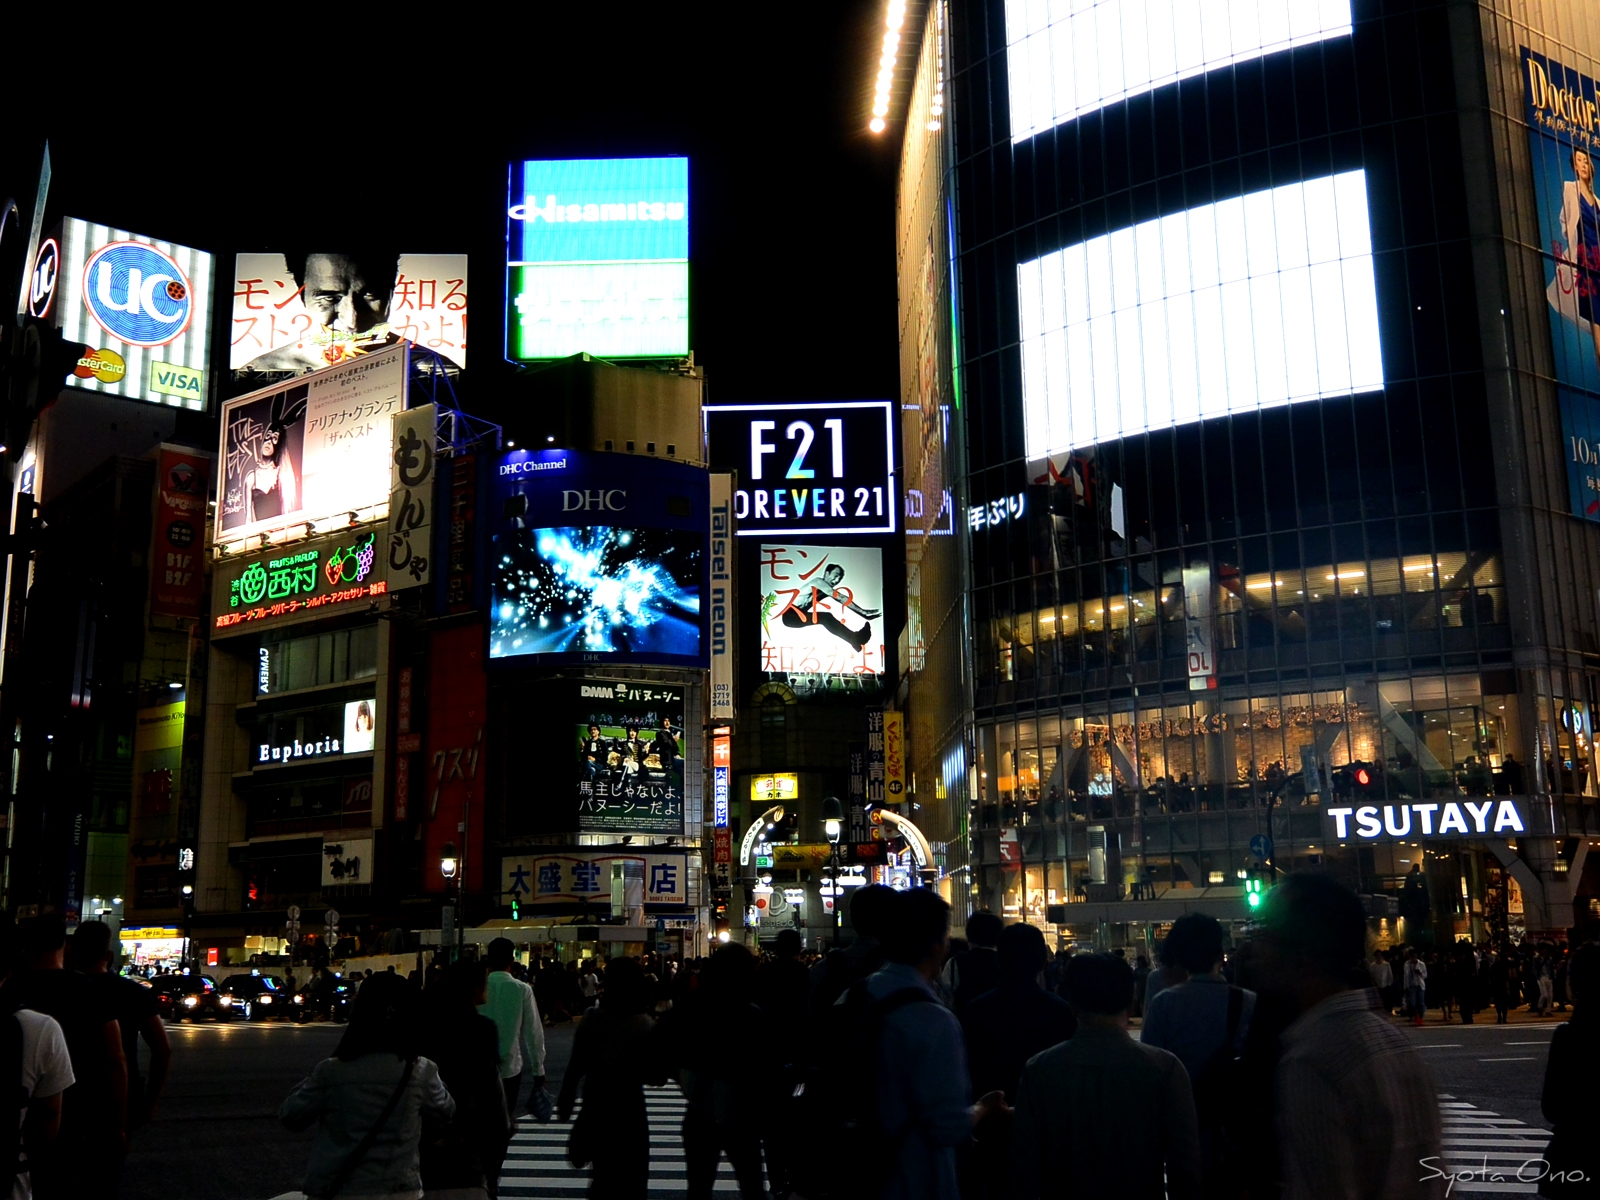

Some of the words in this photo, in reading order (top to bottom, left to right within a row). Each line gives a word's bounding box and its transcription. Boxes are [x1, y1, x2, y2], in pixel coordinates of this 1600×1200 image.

[508, 194, 685, 223] Hisamitsu
[233, 278, 307, 310] モン
[394, 274, 468, 311] 知る
[231, 313, 313, 350] スト?
[395, 313, 467, 350] かよ!
[158, 370, 201, 393] VISA
[308, 394, 398, 434] アリアナ・グランデ
[750, 418, 844, 480] F21
[499, 462, 522, 476] DHC
[523, 458, 567, 472] Channel
[390, 427, 432, 582] もんじゃ
[561, 489, 627, 512] DHC
[735, 487, 846, 519] OREVER
[854, 486, 883, 517] 21
[712, 499, 729, 581] Taisei
[268, 562, 318, 599] 西村
[761, 548, 830, 581] モン
[772, 585, 855, 625] スト?
[712, 588, 729, 655] neon
[583, 653, 604, 662] DHC
[761, 640, 886, 675] 知るかよ!
[580, 685, 614, 699] DMM
[628, 688, 681, 703] バヌーシー
[712, 691, 730, 700] 3719
[712, 699, 730, 708] 2468
[713, 683, 730, 692] (03)
[258, 736, 341, 763] Euphoria
[868, 711, 885, 802] 洋服の青山
[345, 780, 372, 806] JTB
[578, 781, 681, 800] 馬主じゃないよ、
[889, 782, 902, 792] 4F
[578, 799, 681, 816] バヌーシーだよ!
[1327, 799, 1525, 840] TSUTAYA
[73, 813, 83, 846] MIZUHO
[715, 833, 729, 861] 焼肉
